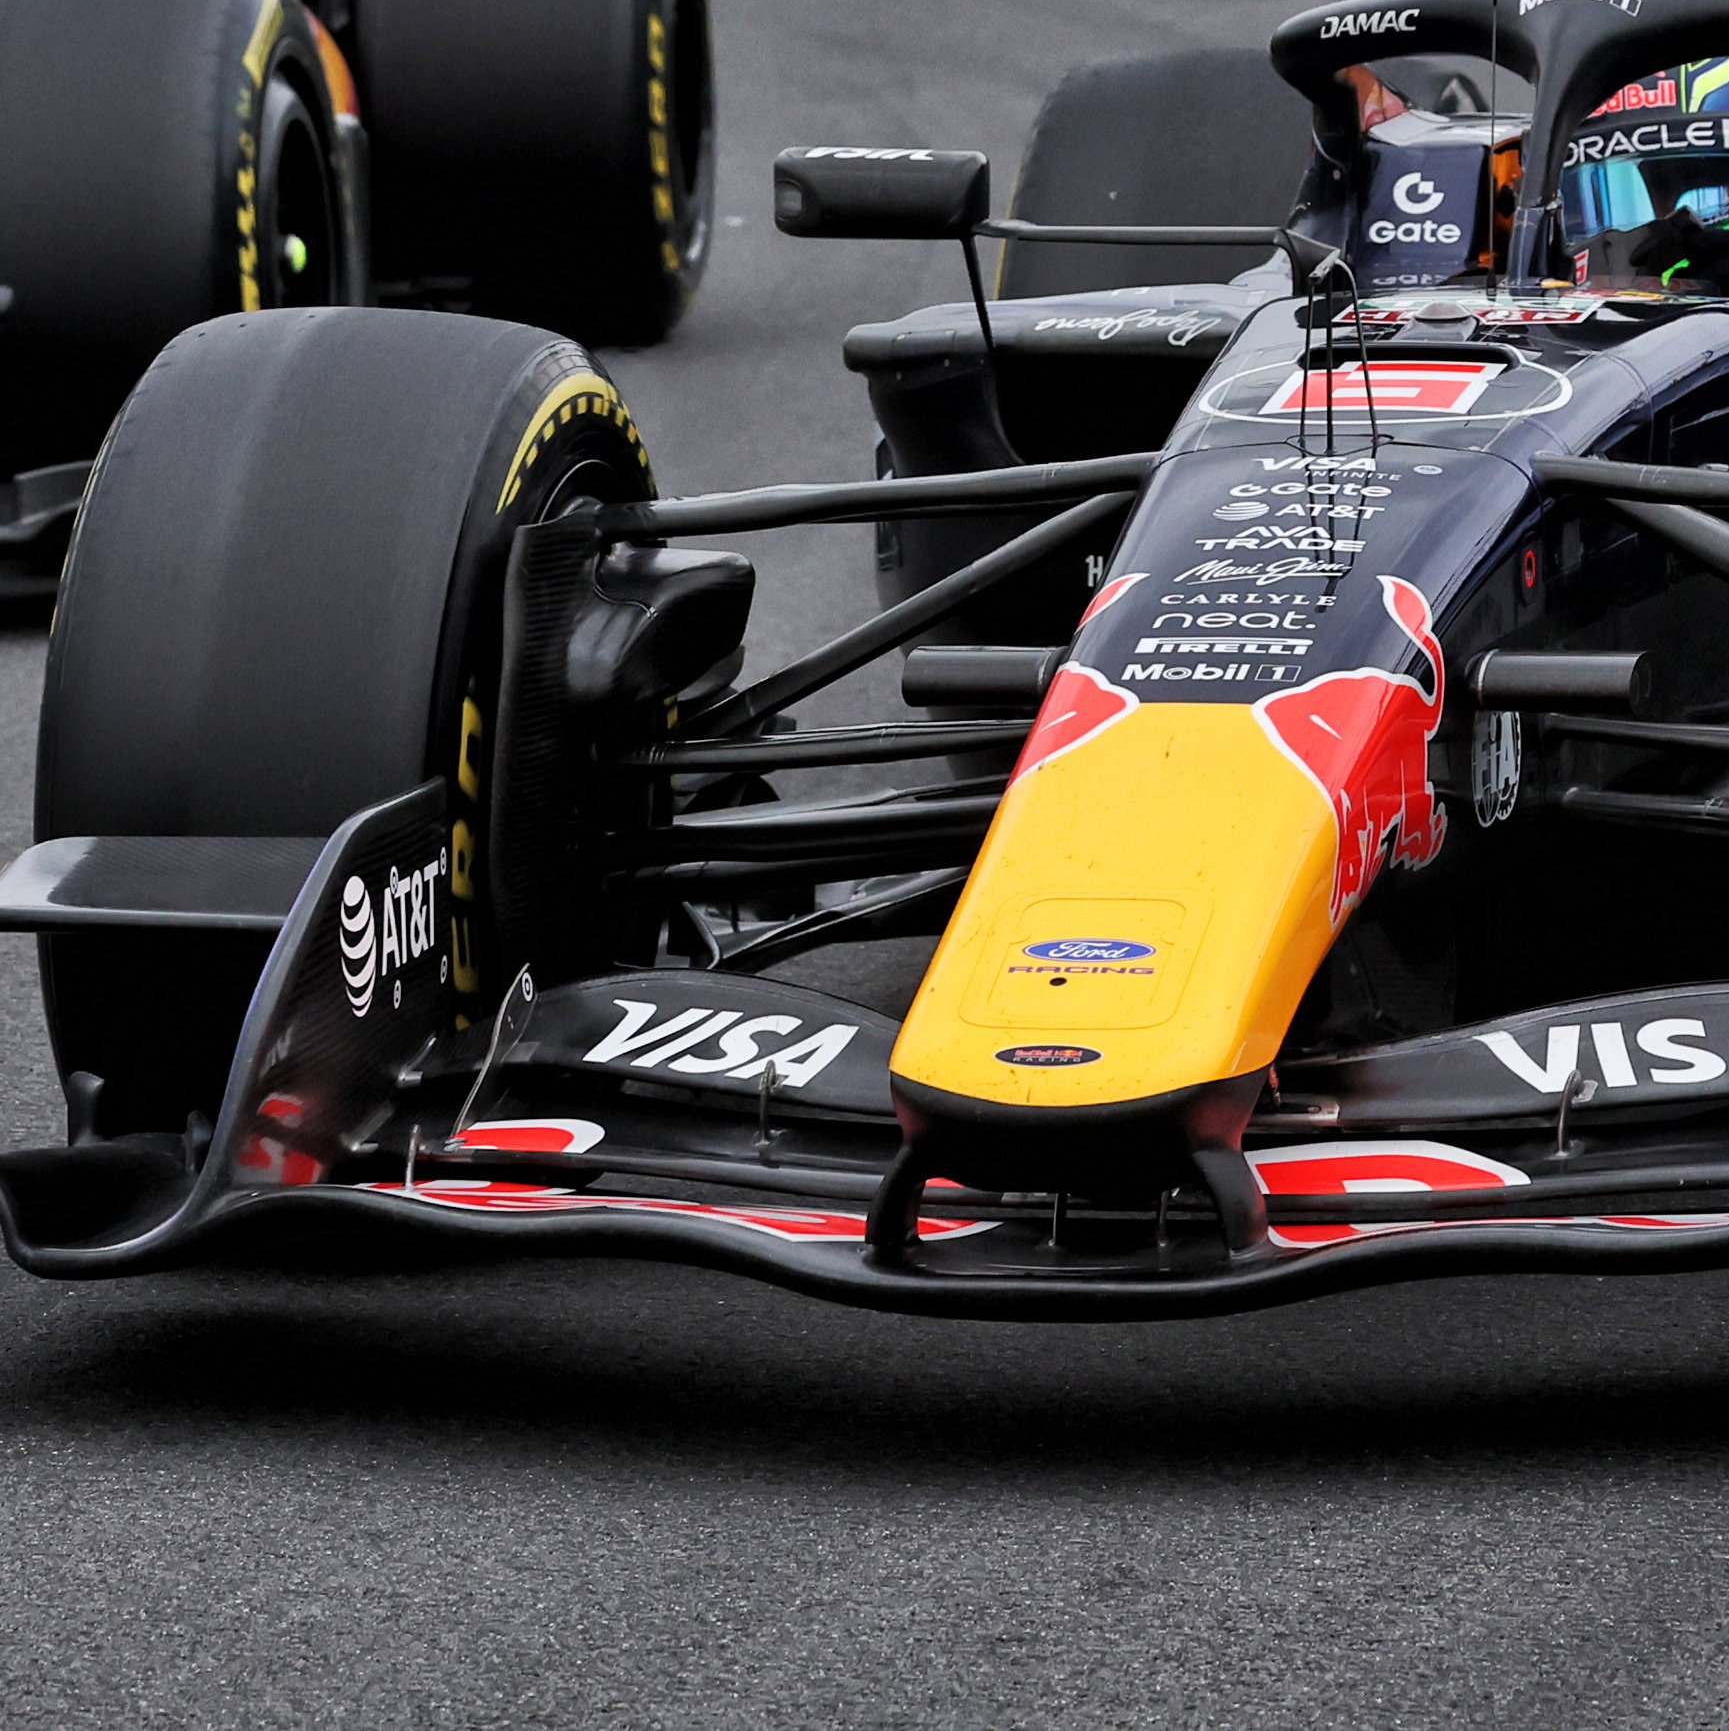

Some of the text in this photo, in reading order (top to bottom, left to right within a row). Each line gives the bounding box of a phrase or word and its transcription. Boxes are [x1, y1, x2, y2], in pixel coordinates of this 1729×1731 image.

[1320, 8, 1420, 39] DAMAC
[1625, 81, 1676, 110] Bull
[1368, 219, 1462, 244] Gate
[1034, 308, 1222, 346] Pepe Jeans
[1253, 457, 1378, 471] VISA
[1304, 471, 1402, 481] INFINITE
[1271, 483, 1392, 497] Gate
[1275, 503, 1385, 520] AT&T
[1236, 525, 1331, 538] AVA
[1195, 538, 1367, 552] TRADE
[1173, 557, 1353, 586] Maui Jim
[1160, 594, 1337, 607] CARLYLE
[1134, 637, 1314, 656] PIRELLI
[1121, 664, 1251, 681] Mobil
[381, 859, 440, 976] AT&T
[1047, 941, 1129, 961] Ford
[1007, 965, 1155, 975] RACING
[583, 998, 860, 1089] VISA
